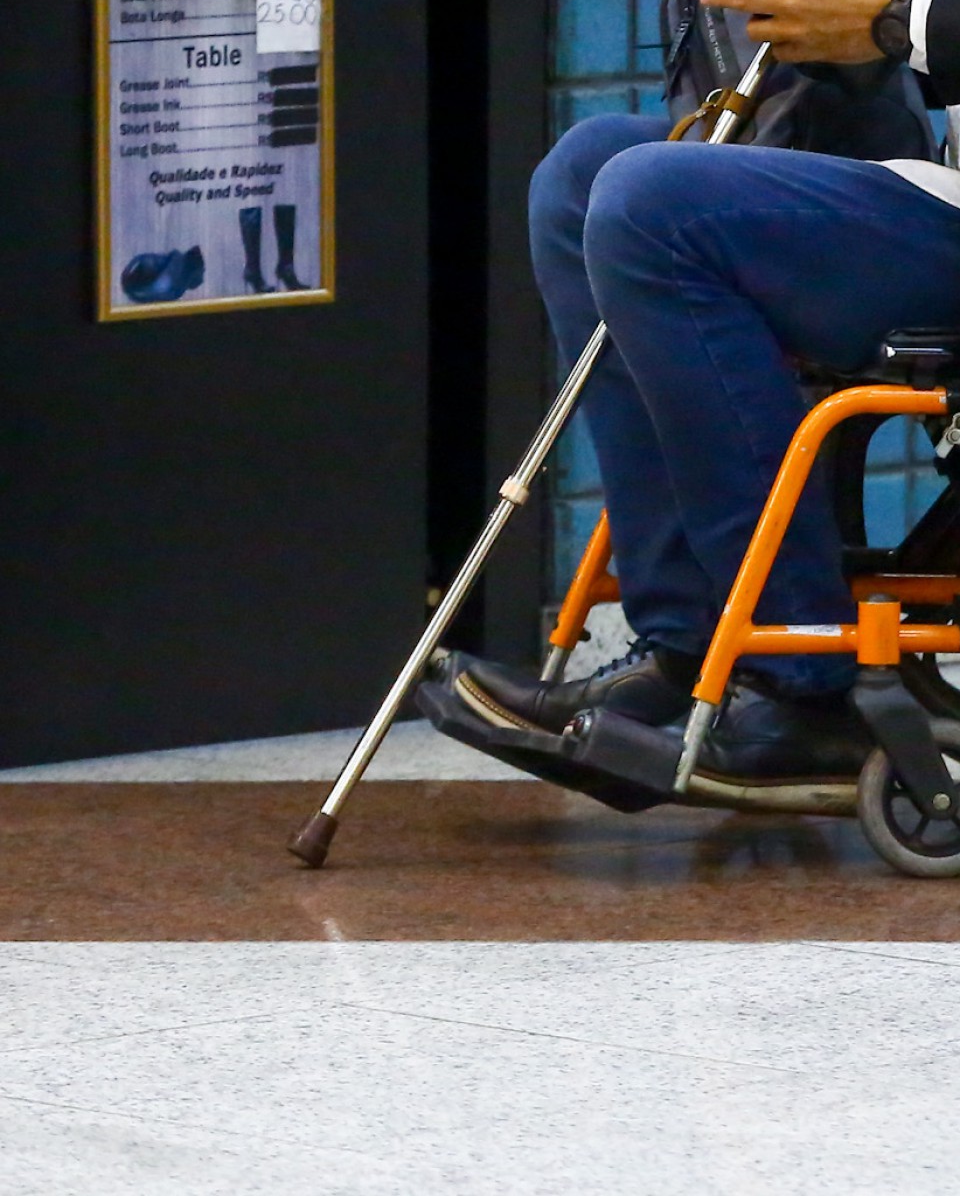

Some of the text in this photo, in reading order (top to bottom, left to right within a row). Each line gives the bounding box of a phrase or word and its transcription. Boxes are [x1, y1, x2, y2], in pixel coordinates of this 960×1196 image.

[182, 44, 242, 69] Table
[120, 122, 150, 136] Short
[154, 121, 180, 133] Boot
[150, 163, 284, 187] Qualidade e Rapidez
[156, 183, 275, 206] Quality and Speed
